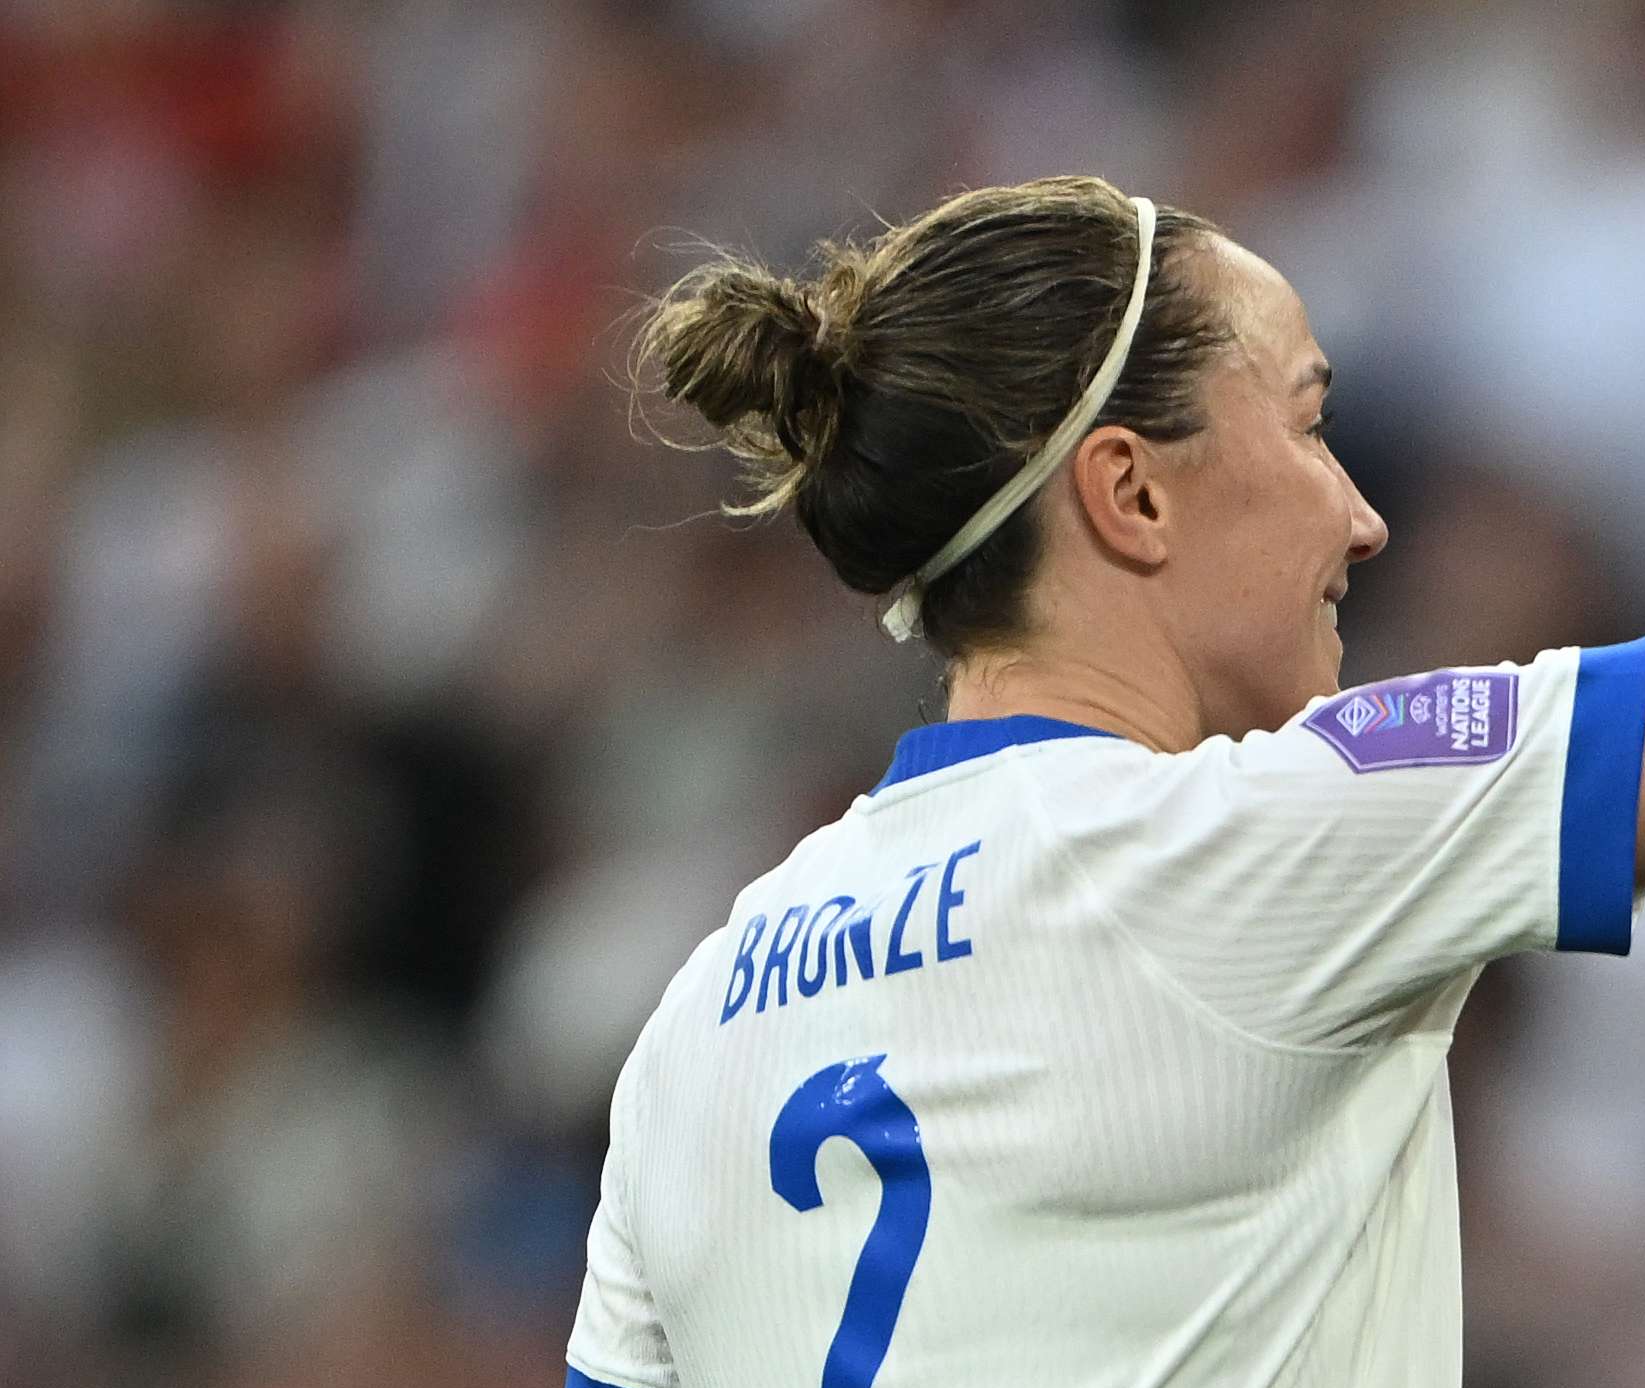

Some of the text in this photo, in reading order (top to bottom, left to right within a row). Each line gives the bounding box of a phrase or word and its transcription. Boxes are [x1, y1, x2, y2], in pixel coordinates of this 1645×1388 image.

[1451, 678, 1470, 750] NATIONS
[1471, 679, 1491, 748] LEAGUE
[719, 839, 981, 1026] BRONZE
